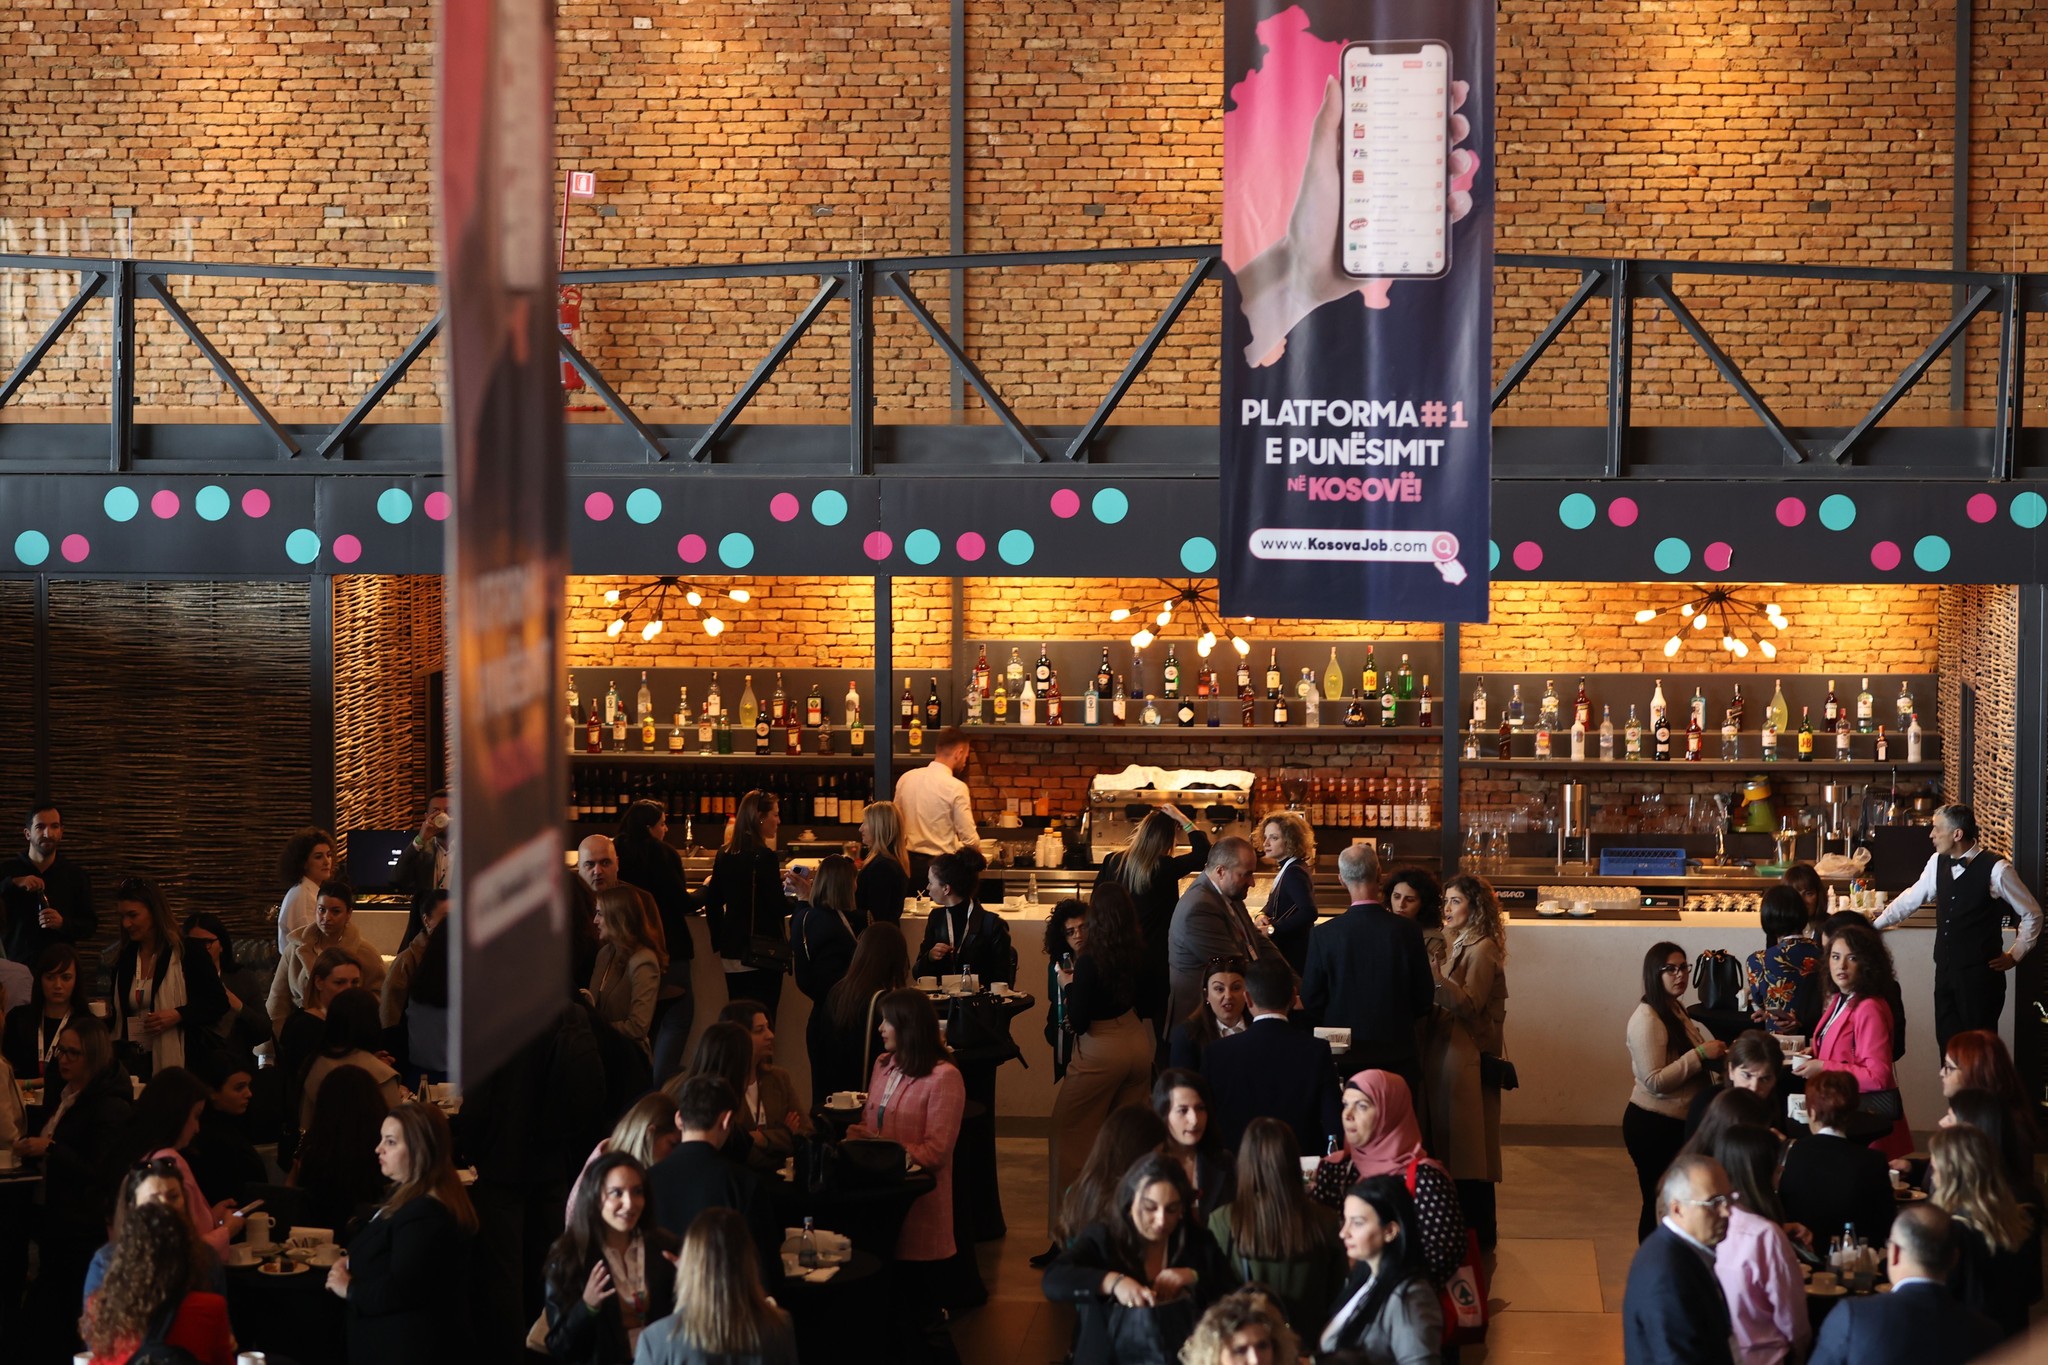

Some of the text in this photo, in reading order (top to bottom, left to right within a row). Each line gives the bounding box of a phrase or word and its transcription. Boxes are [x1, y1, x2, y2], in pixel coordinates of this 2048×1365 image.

[1241, 398, 1469, 428] PLATFORMA #1
[1265, 431, 1445, 466] E PUNËSIMIT
[1287, 471, 1422, 502] NË KOSOVË!
[1261, 537, 1427, 552] www.KosovaJob.com
